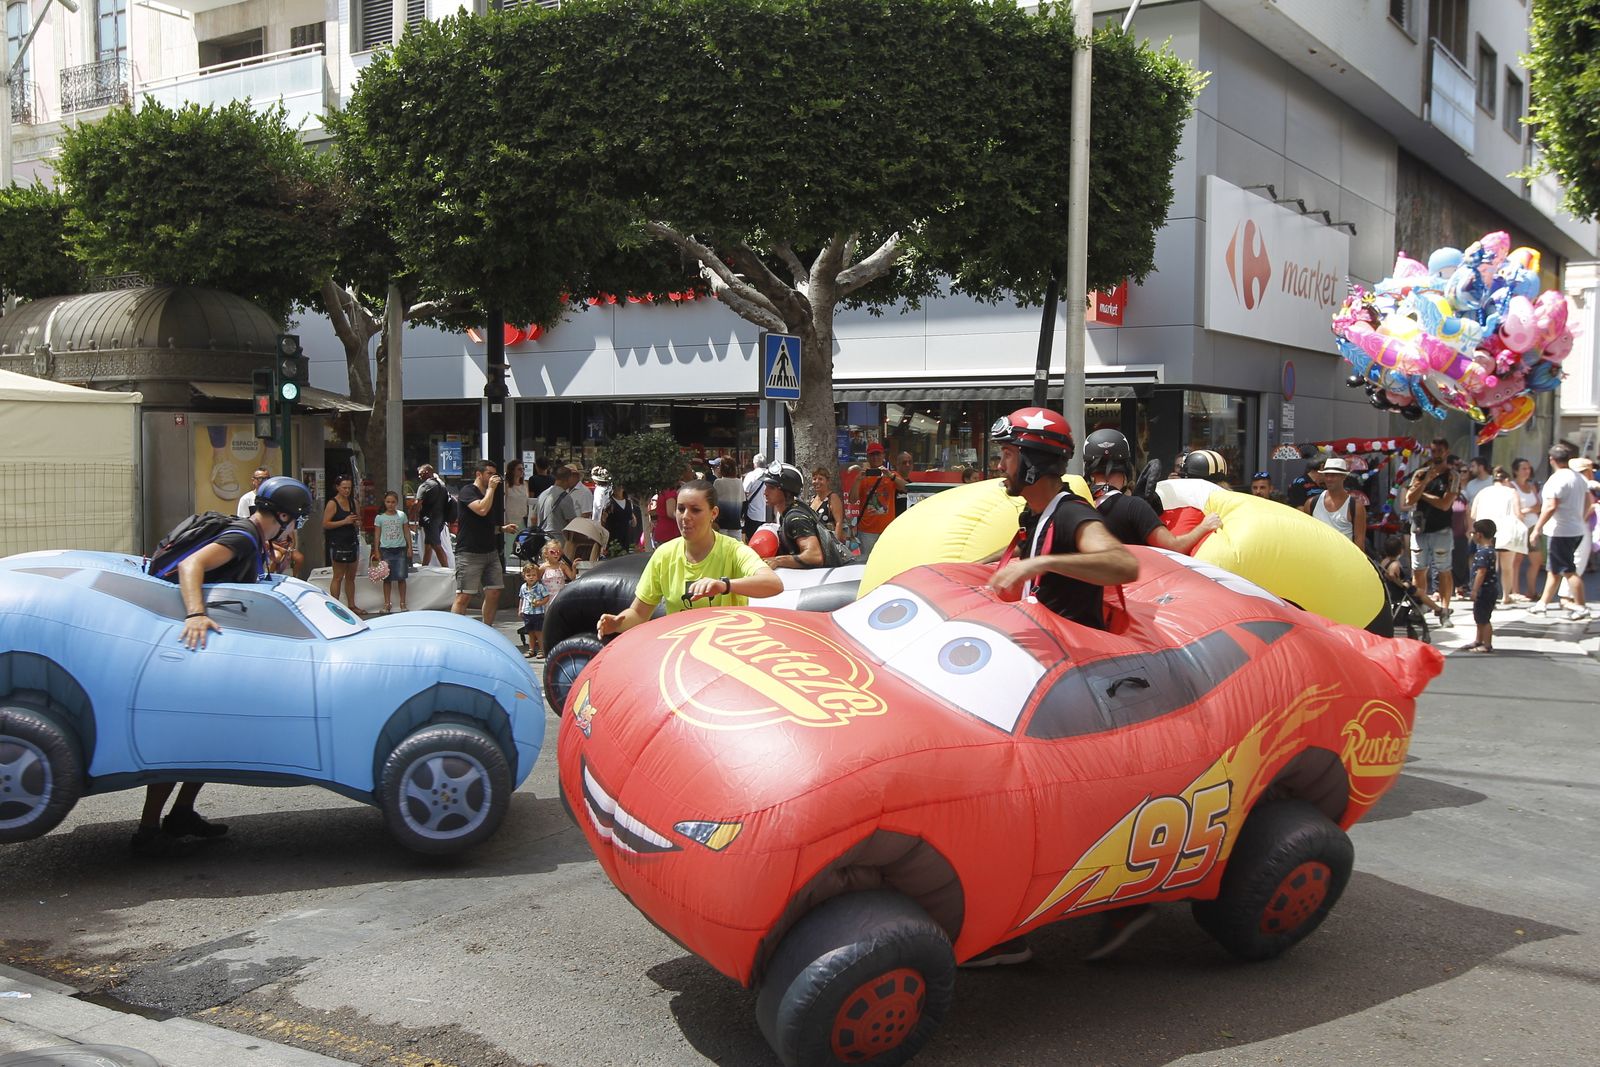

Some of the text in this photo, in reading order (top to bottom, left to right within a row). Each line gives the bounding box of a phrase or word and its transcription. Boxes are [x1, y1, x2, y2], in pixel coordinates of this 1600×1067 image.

[1099, 302, 1119, 317] market
[1282, 260, 1338, 310] market
[1109, 780, 1233, 901] 95
